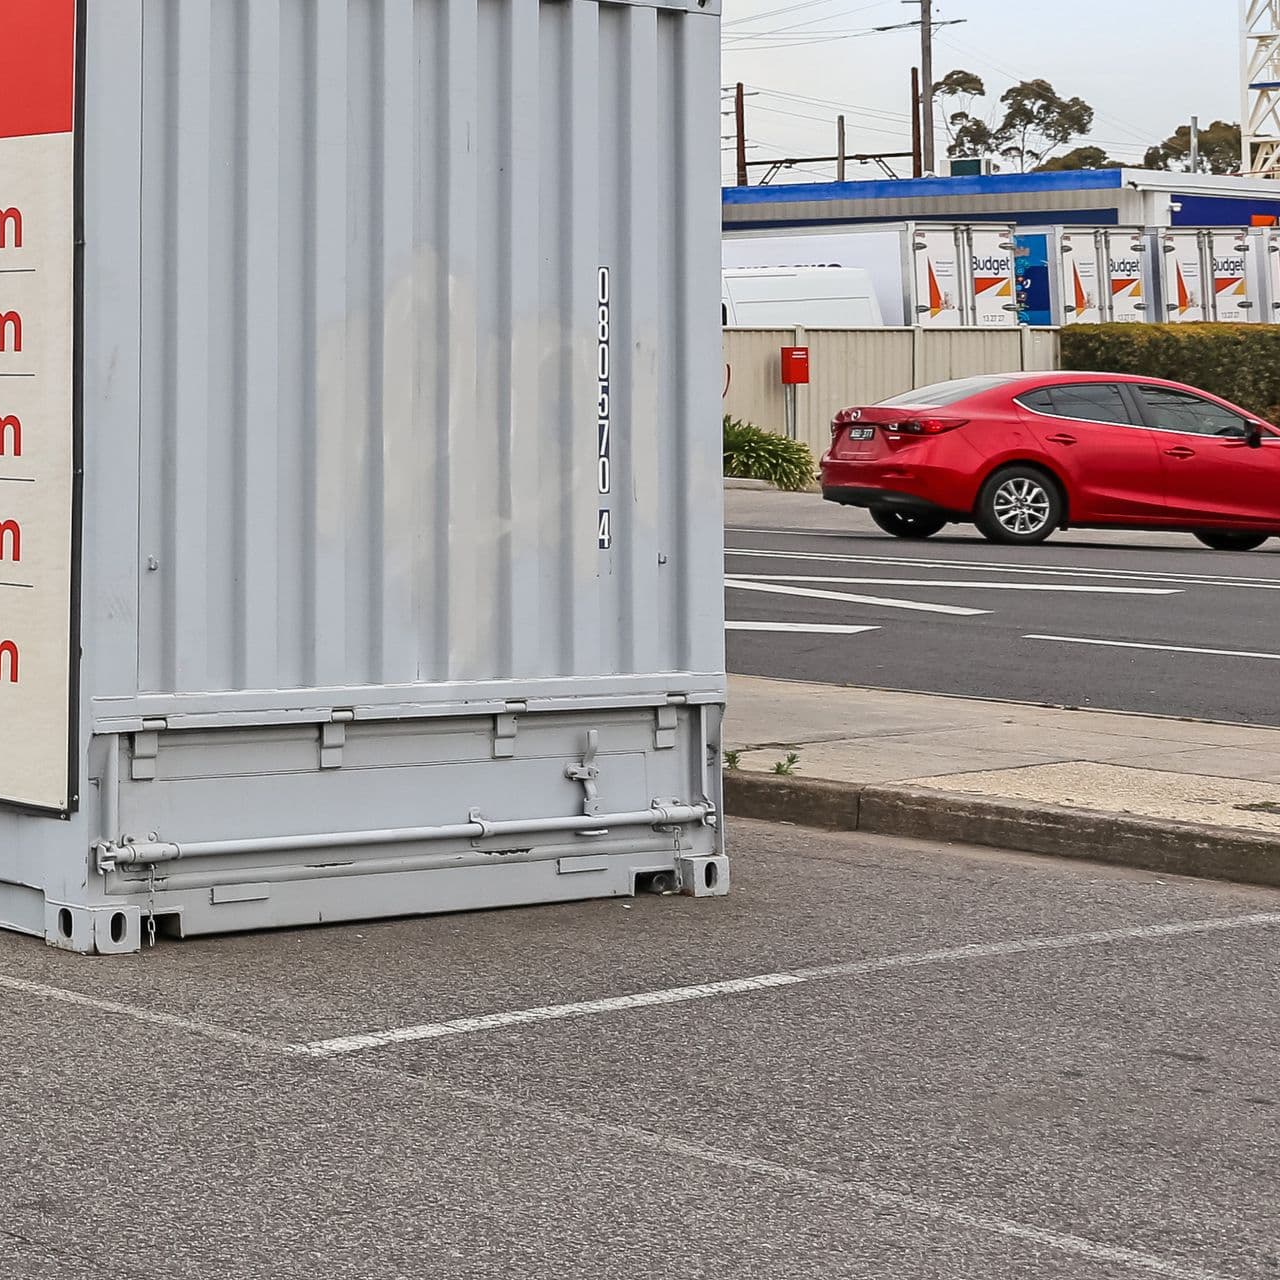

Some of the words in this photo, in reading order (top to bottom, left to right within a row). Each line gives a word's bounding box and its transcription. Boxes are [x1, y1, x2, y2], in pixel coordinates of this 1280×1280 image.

[971, 254, 1011, 276] Budget
[1109, 257, 1140, 277] Budget
[1212, 256, 1245, 276] Budget
